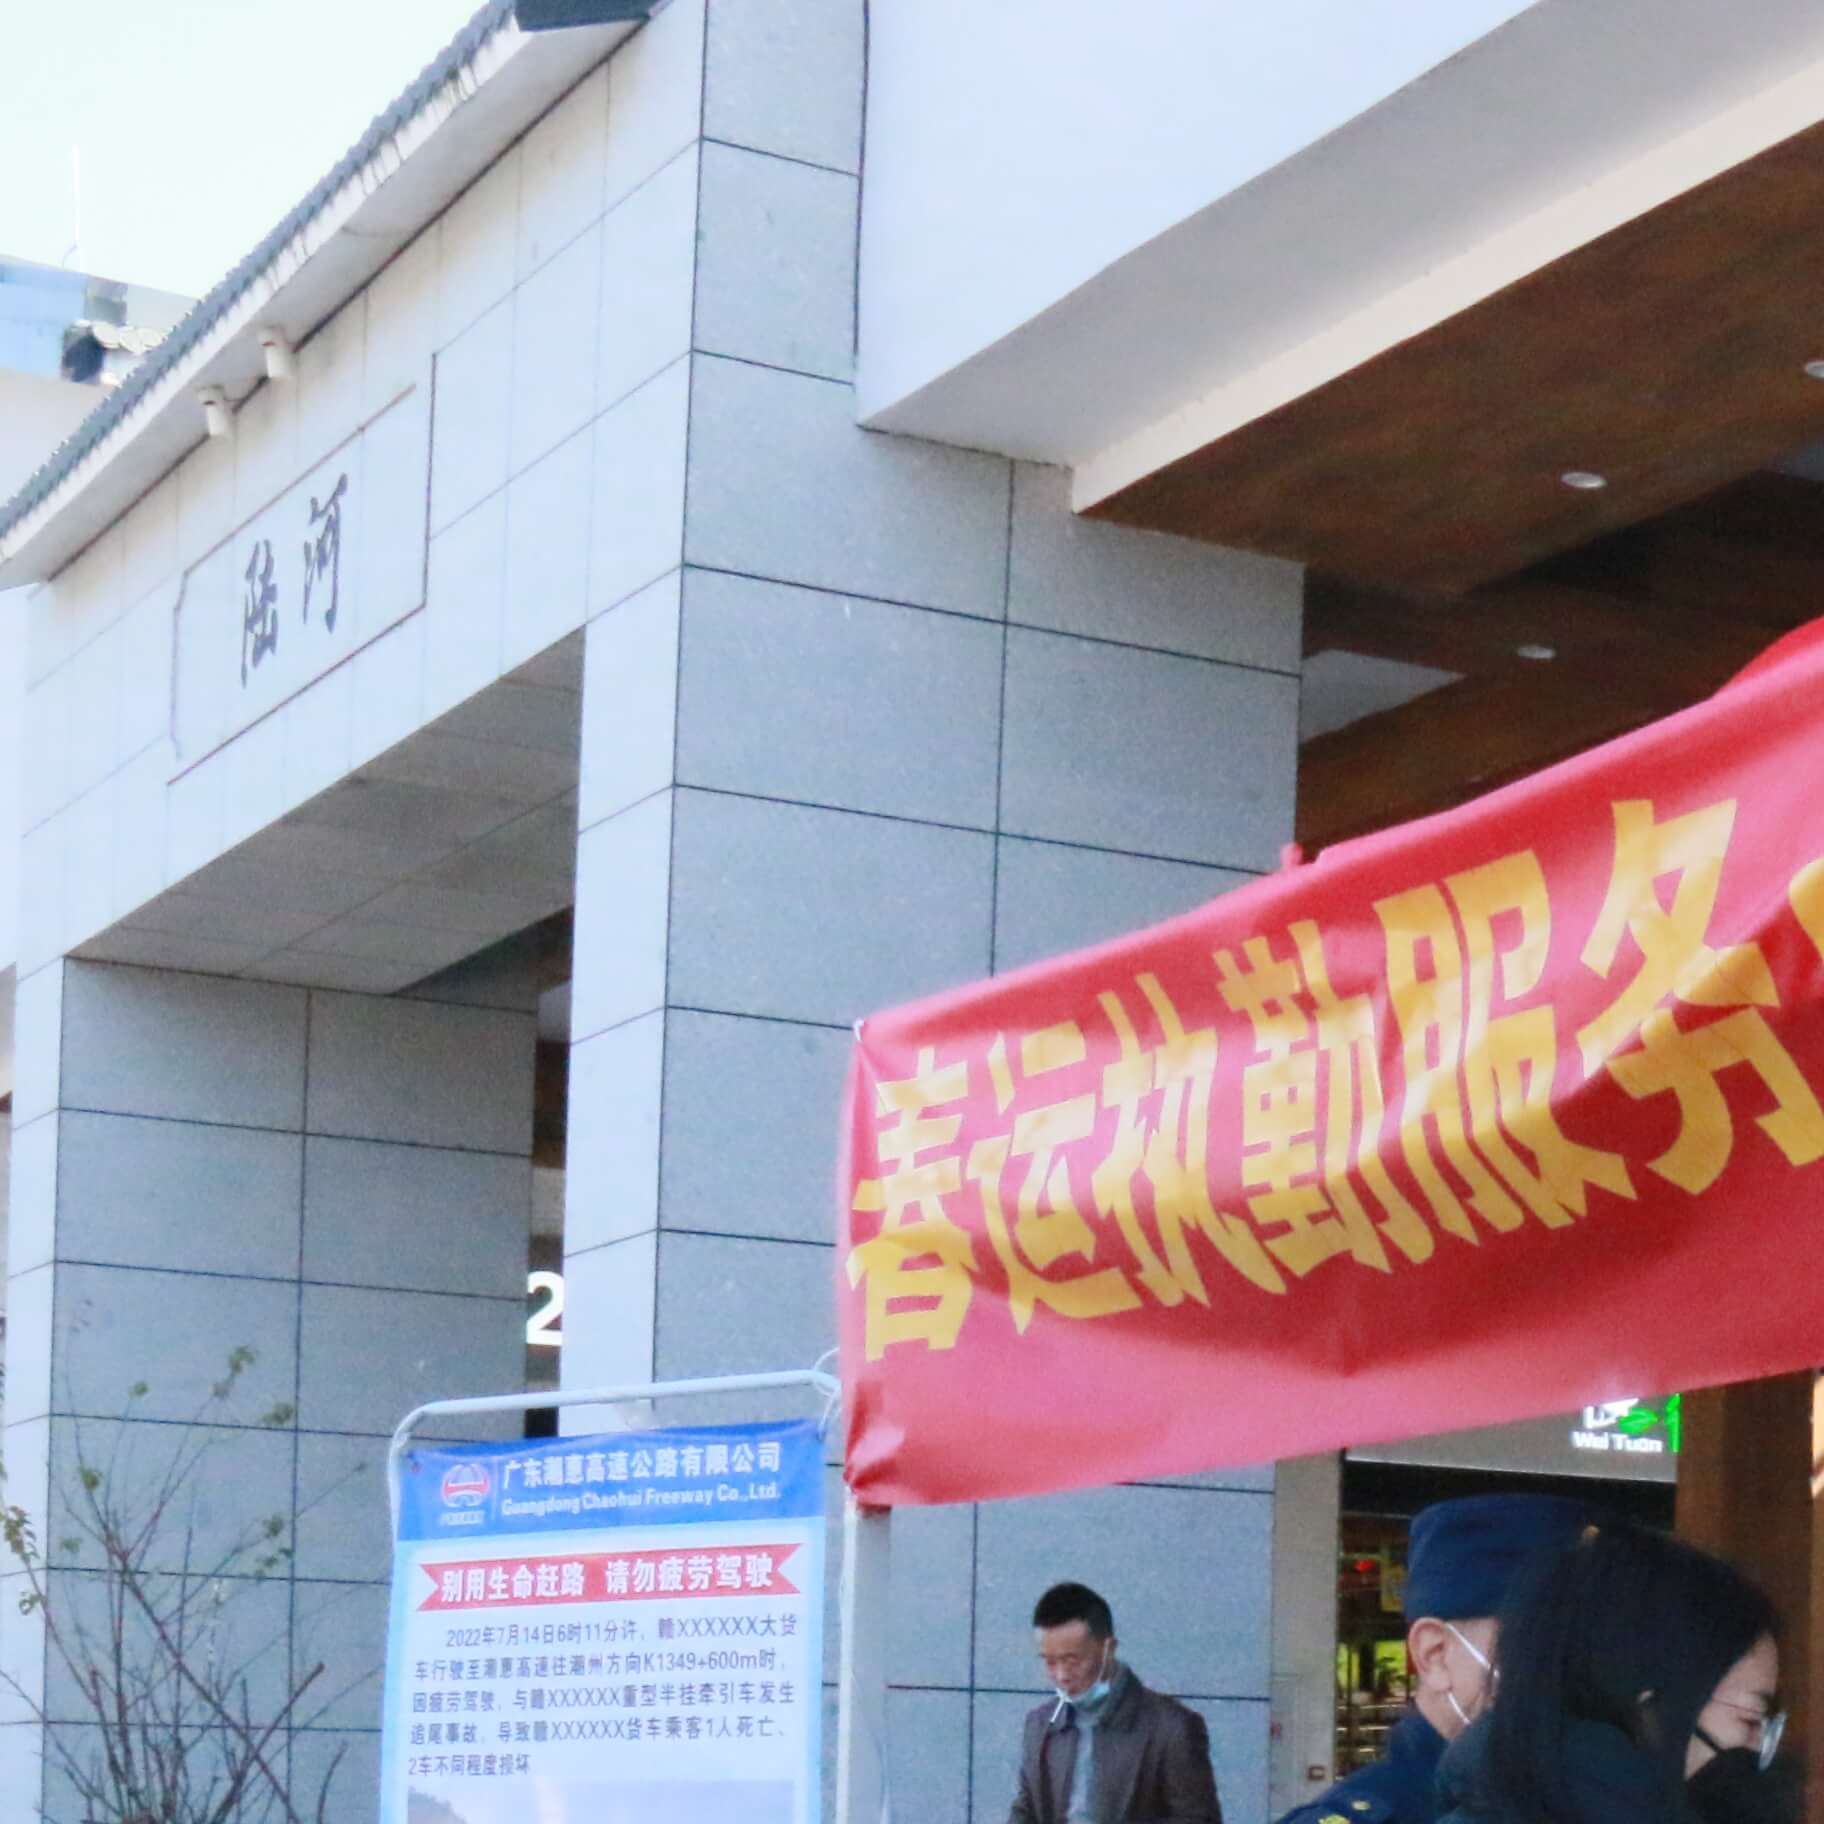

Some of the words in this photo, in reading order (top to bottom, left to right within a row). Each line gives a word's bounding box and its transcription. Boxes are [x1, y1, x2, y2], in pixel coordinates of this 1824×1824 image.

[240, 472, 351, 688] 陆河
[645, 1485, 714, 1506] Freeway
[440, 1561, 586, 1605] 别用生命赶路
[604, 1552, 774, 1596] 请勿疲劳驾驶
